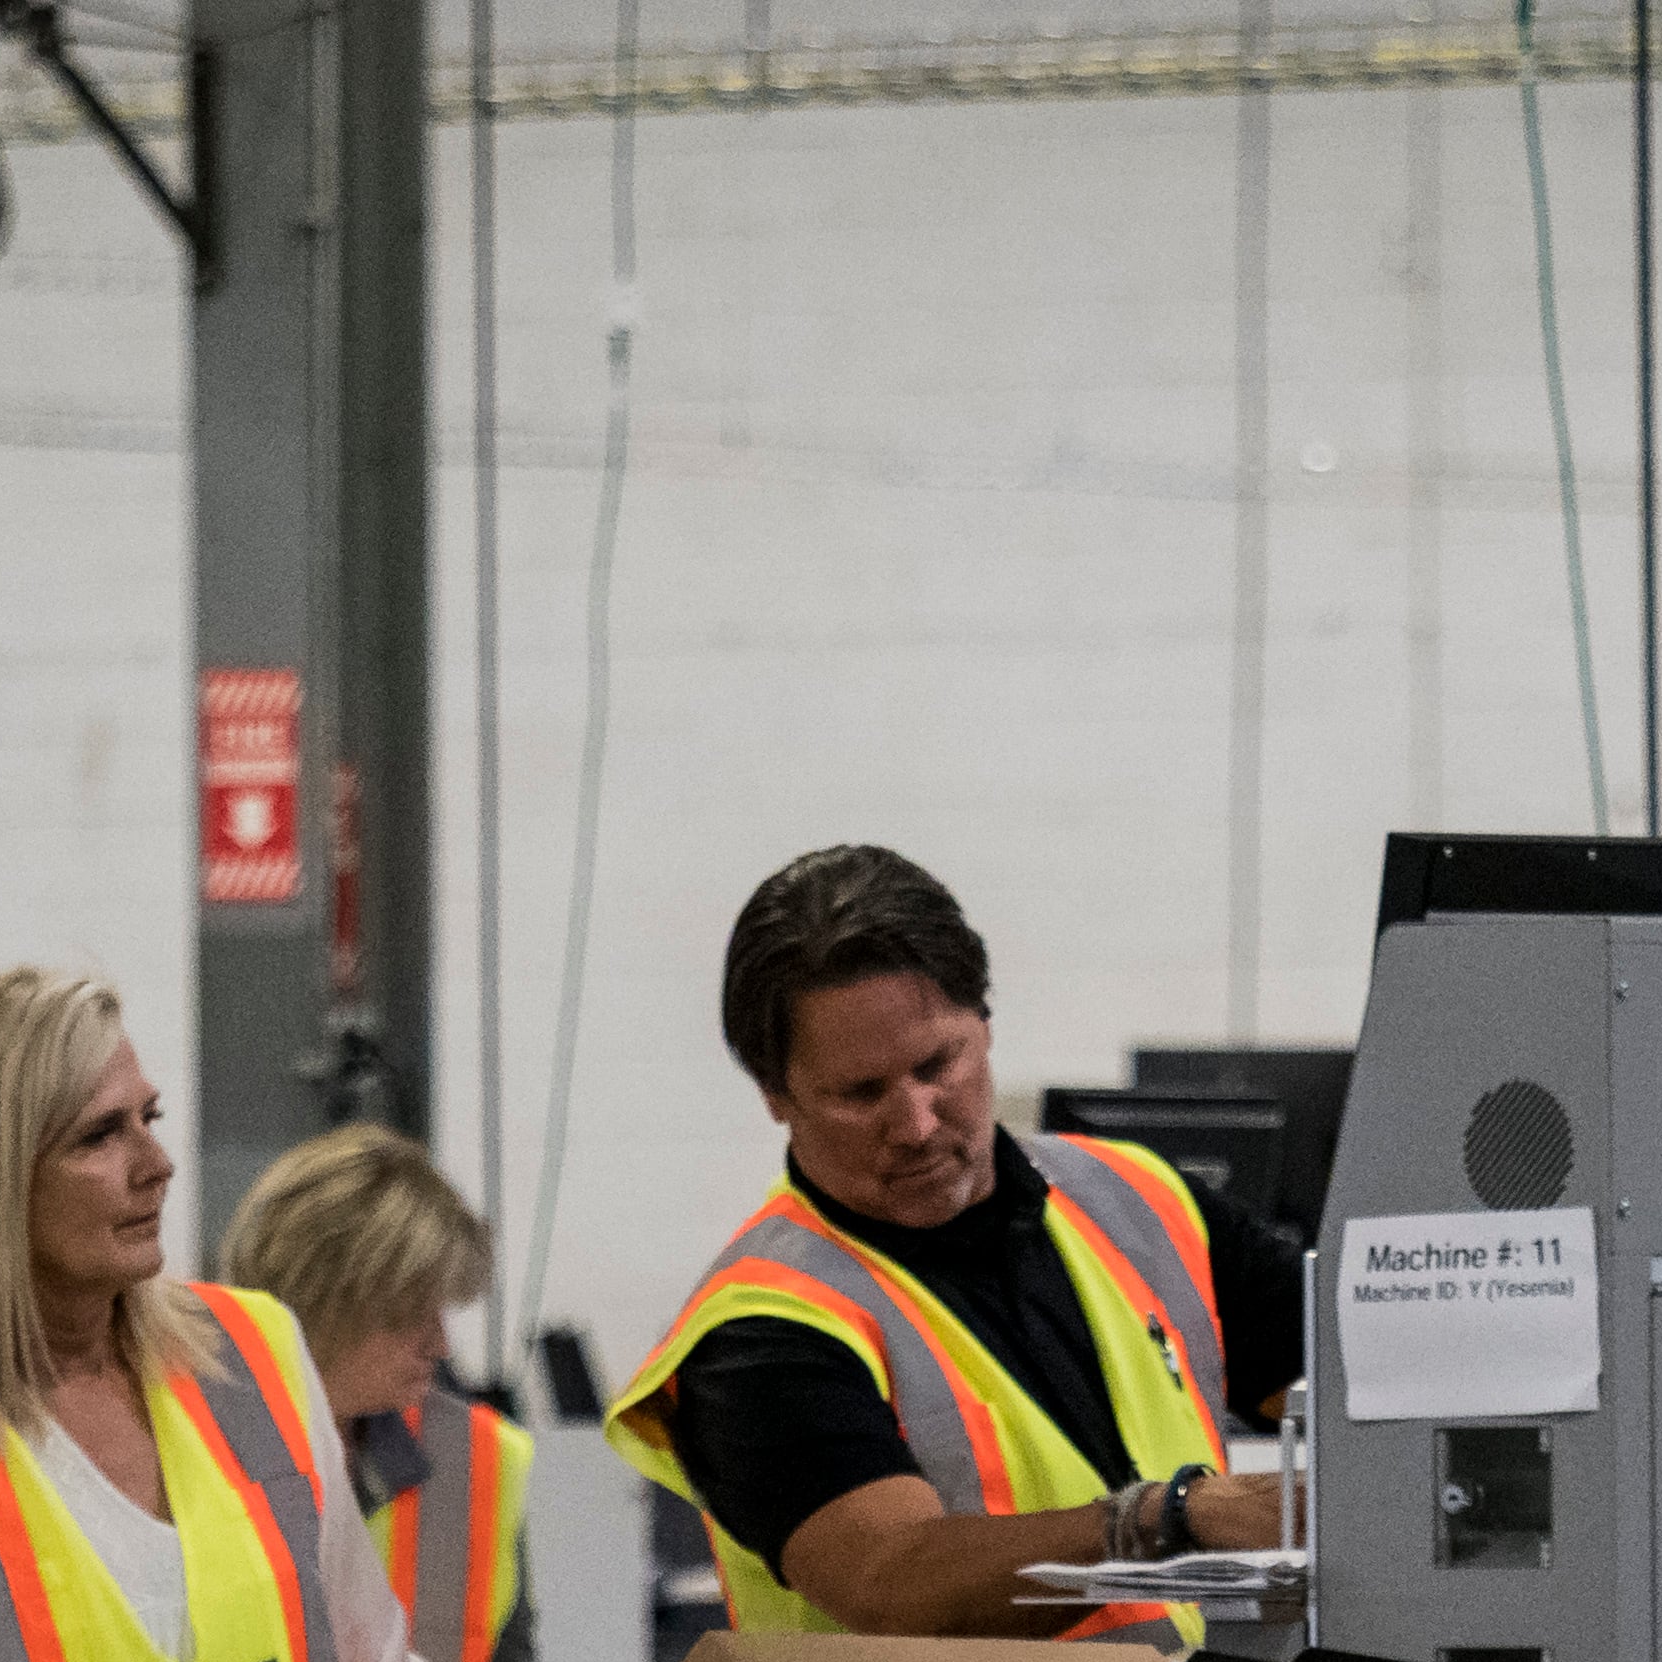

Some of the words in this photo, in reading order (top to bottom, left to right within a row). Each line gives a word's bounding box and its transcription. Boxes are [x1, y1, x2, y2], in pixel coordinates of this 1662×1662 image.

[1366, 1241, 1487, 1273] Machine
[1497, 1239, 1523, 1268] #:
[1531, 1237, 1562, 1265] 11
[1353, 1283, 1432, 1303] Machine
[1435, 1280, 1463, 1300] ID:
